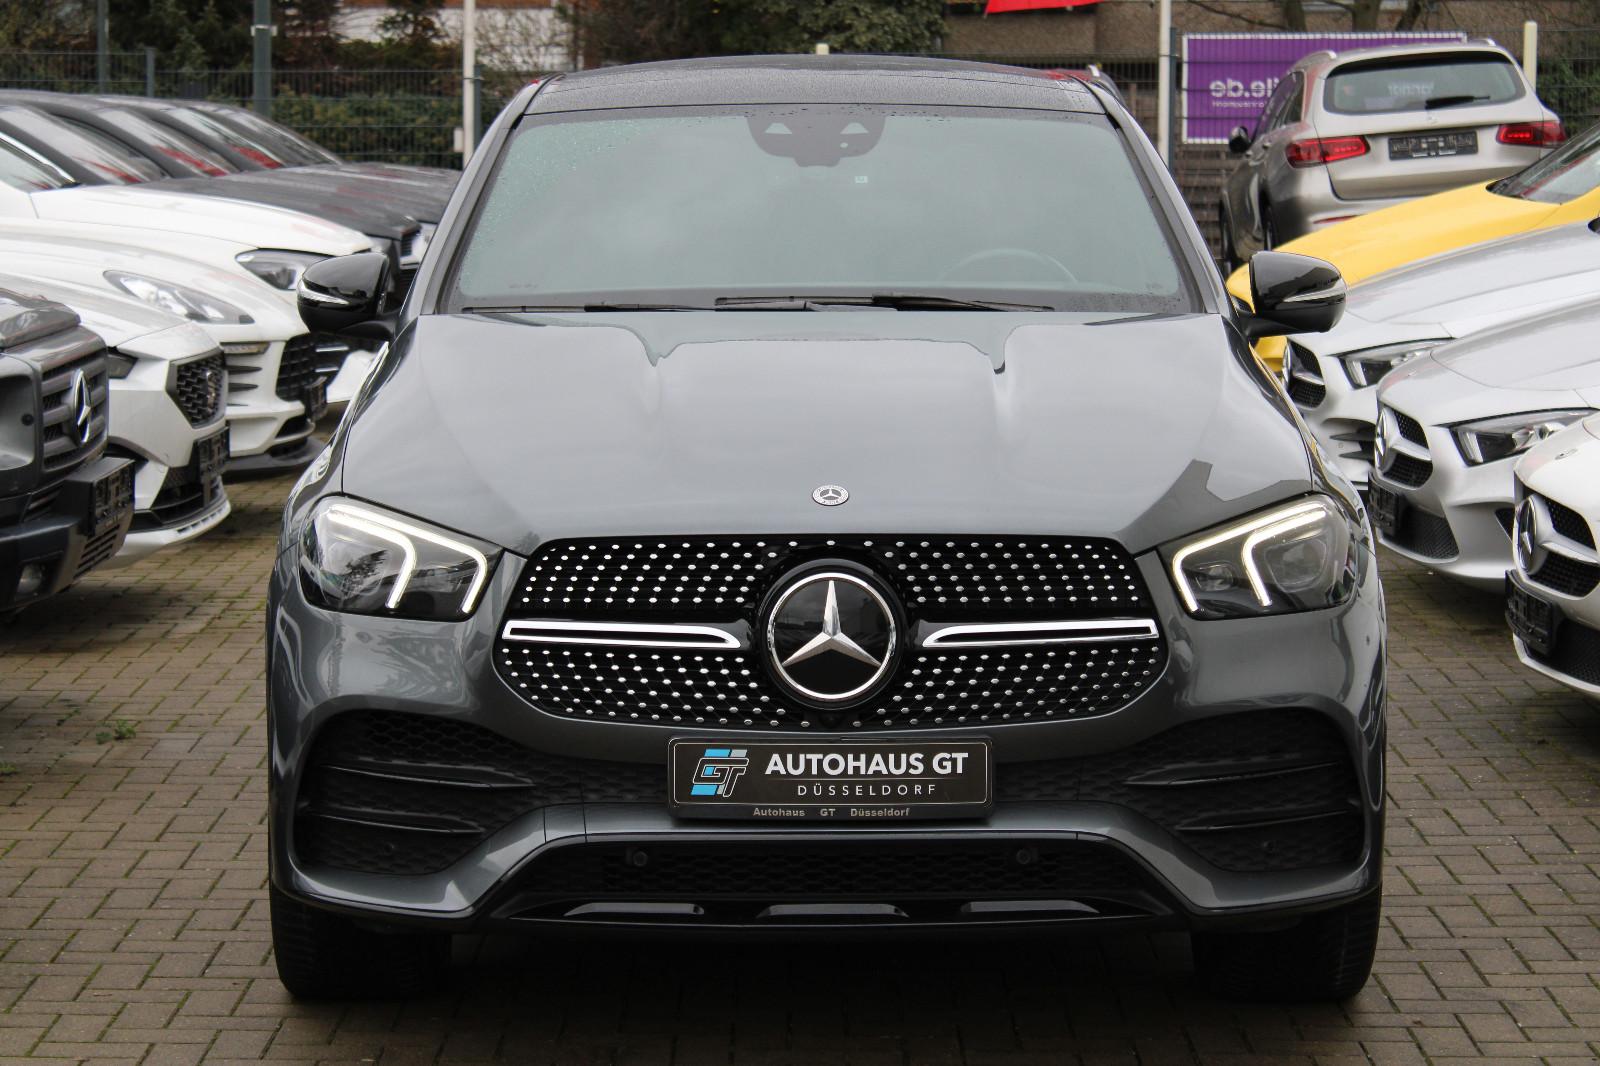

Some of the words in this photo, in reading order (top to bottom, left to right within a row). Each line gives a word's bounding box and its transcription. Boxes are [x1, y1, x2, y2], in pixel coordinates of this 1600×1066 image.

[765, 753, 924, 775] AUTOHAUS
[932, 752, 969, 774] GT
[797, 783, 936, 796] DÜSSELDORF
[753, 807, 806, 817] Autohaus
[820, 808, 836, 817] GT
[850, 807, 910, 817] Düsseldorf
